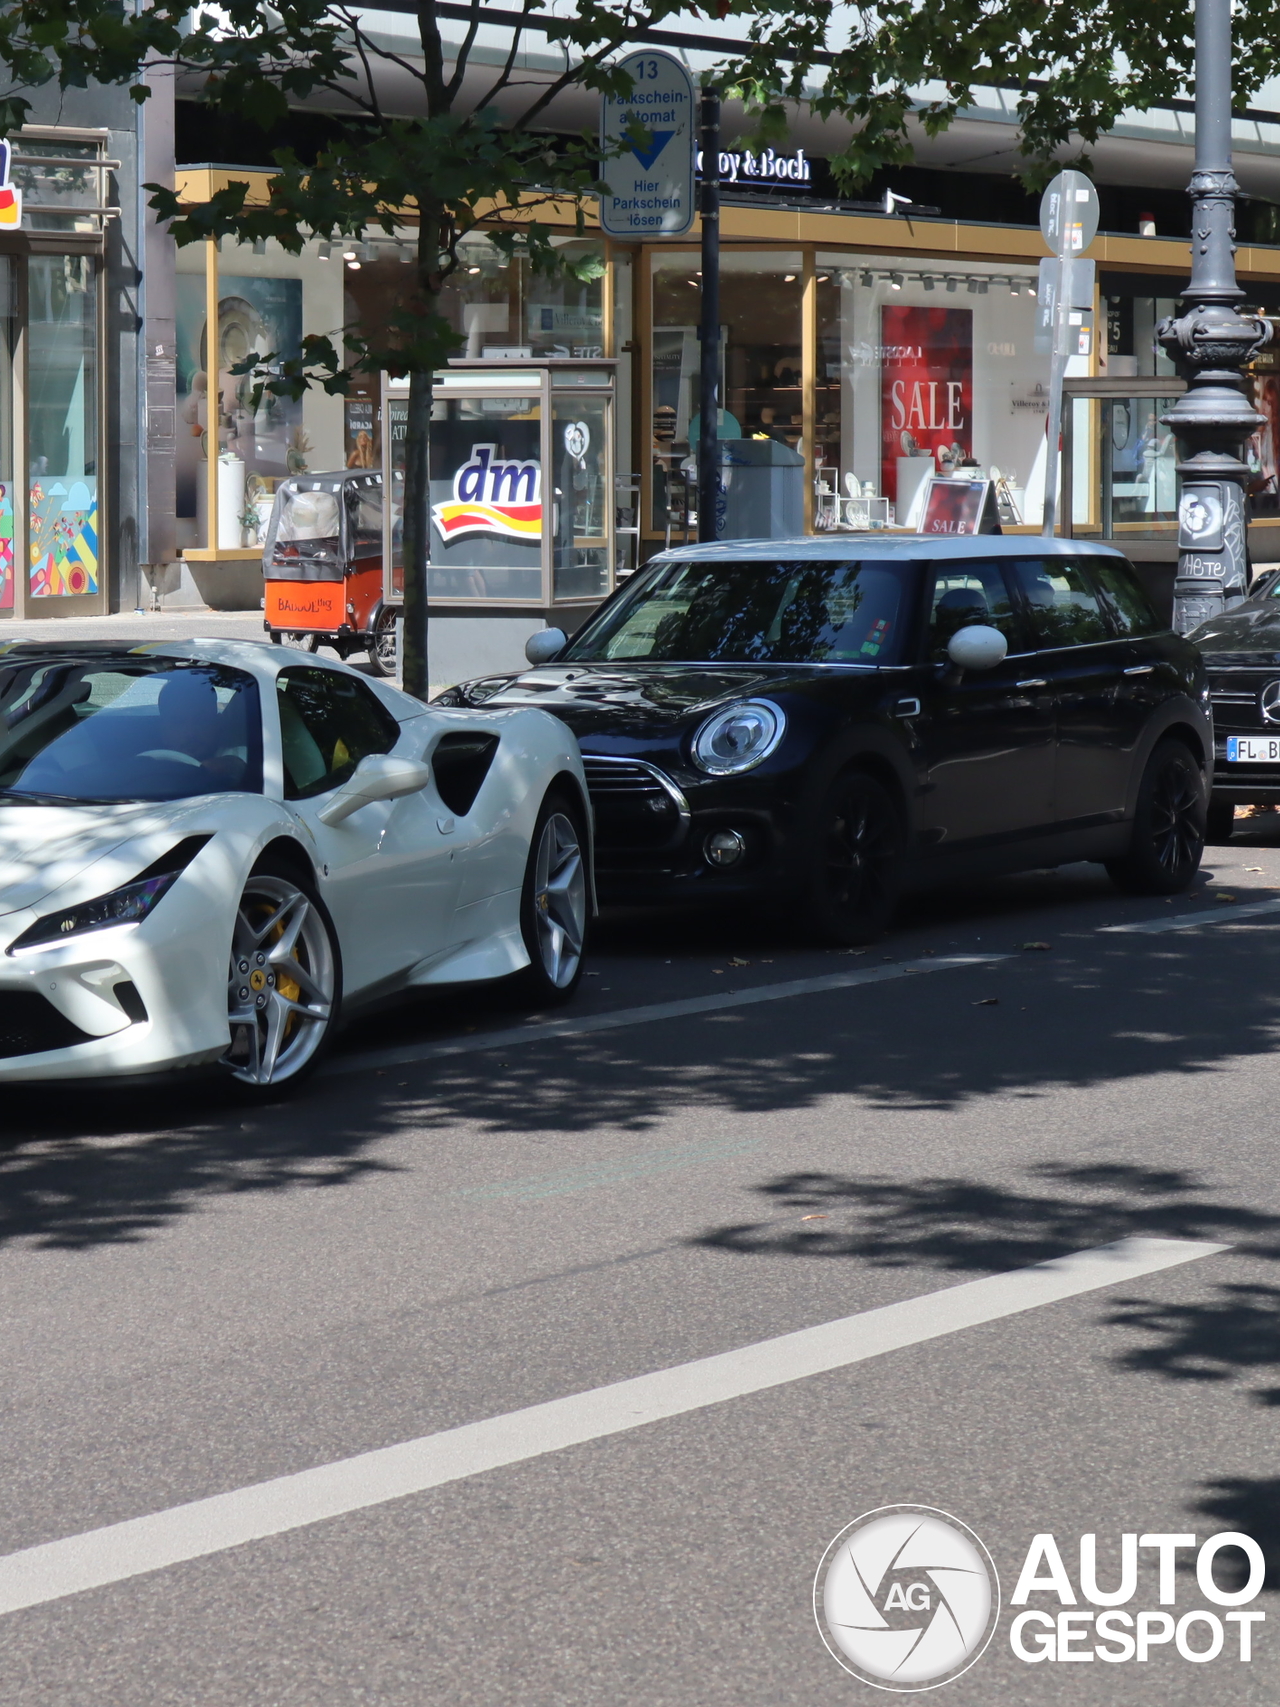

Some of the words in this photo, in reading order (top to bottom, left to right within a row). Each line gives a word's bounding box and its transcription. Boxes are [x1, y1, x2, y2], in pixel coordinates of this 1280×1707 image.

[636, 60, 659, 80] 13
[619, 111, 676, 124] atomat
[760, 147, 810, 180] Boch
[634, 180, 660, 192] Hier
[613, 197, 681, 209] Parkschein
[629, 213, 663, 226] lösen
[891, 380, 964, 430] SALE
[1012, 400, 1040, 408] Villeroy
[458, 449, 538, 502] dm
[932, 519, 967, 534] SALE
[1238, 741, 1257, 758] FL
[1269, 741, 1280, 758] B
